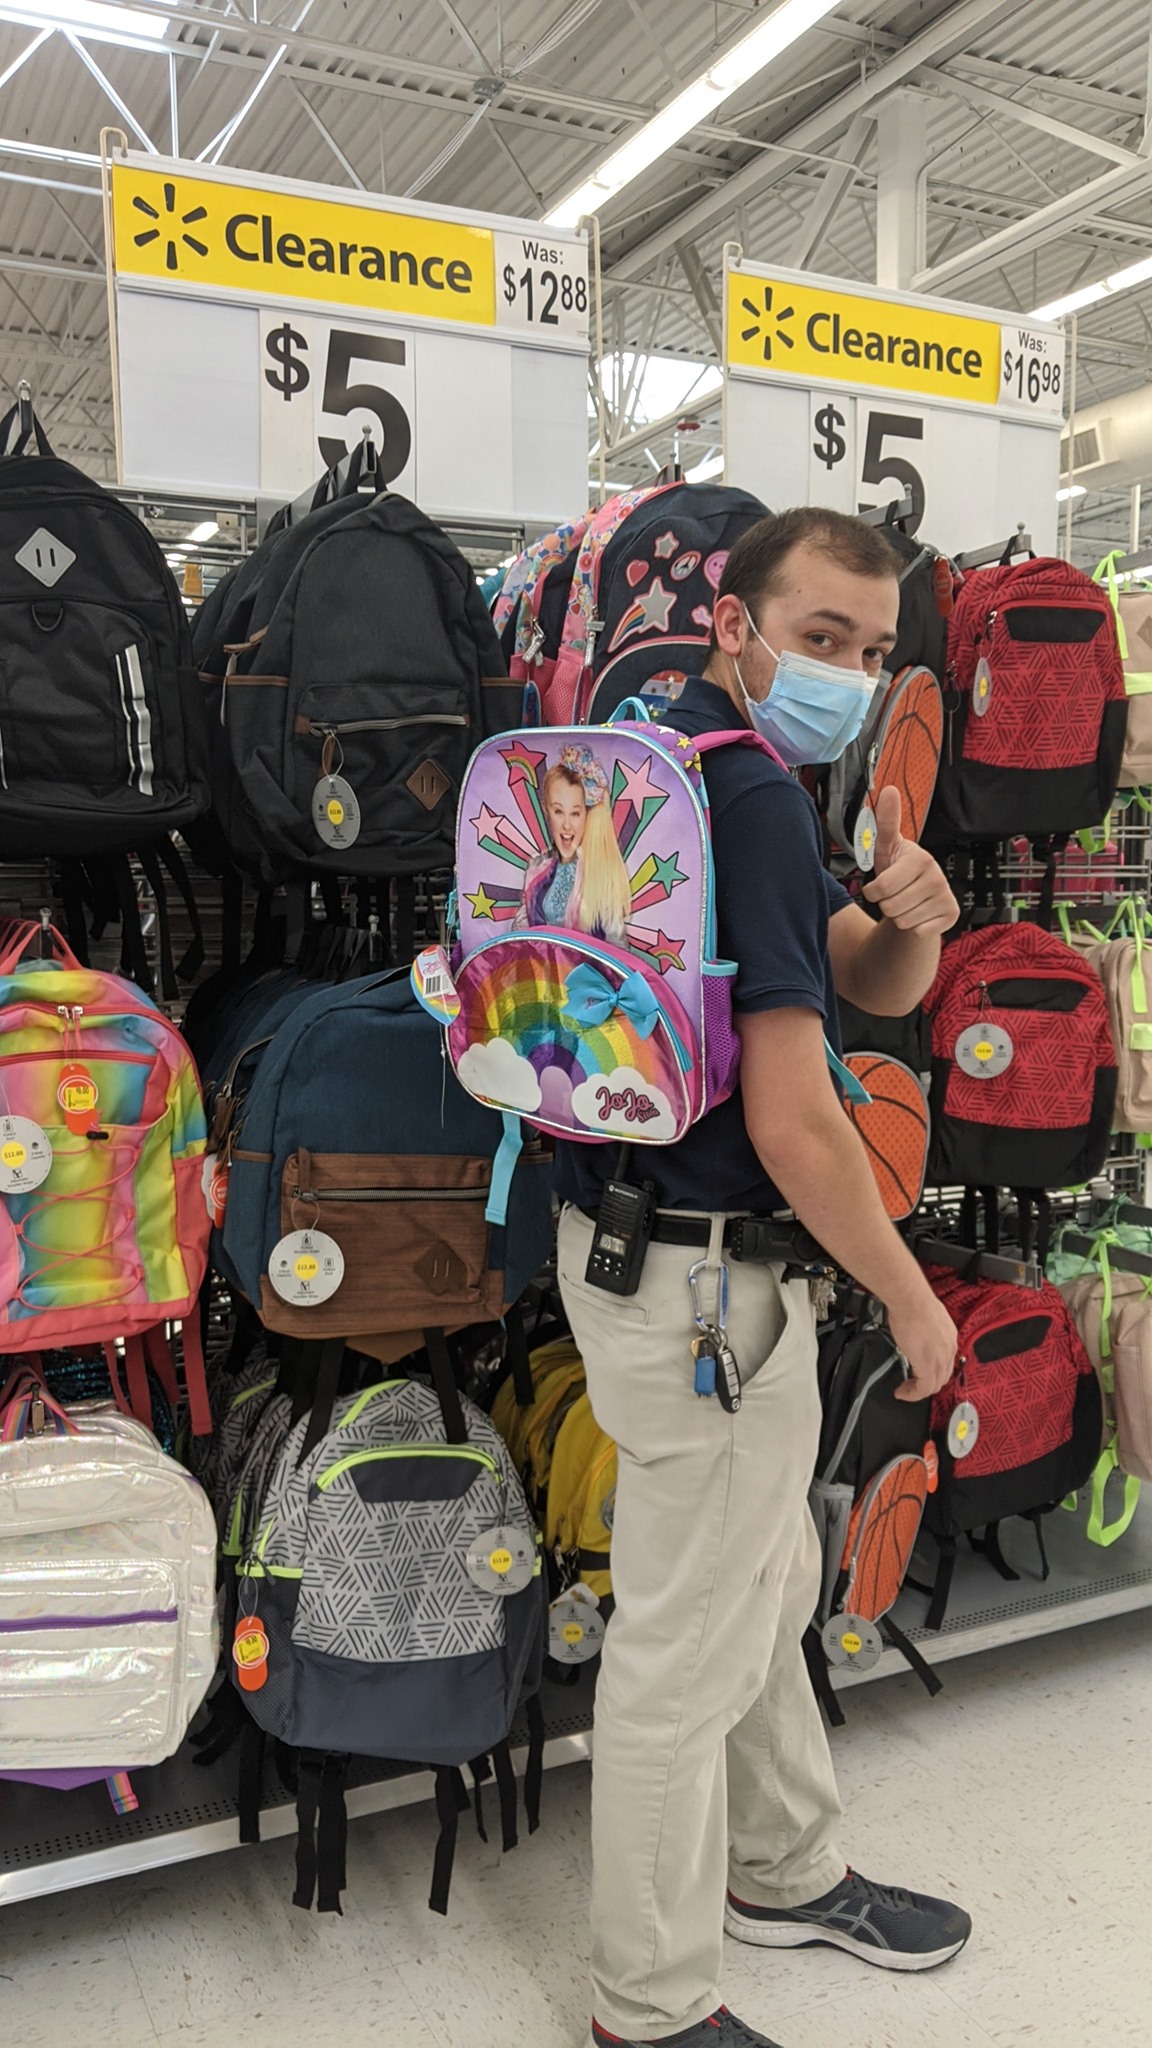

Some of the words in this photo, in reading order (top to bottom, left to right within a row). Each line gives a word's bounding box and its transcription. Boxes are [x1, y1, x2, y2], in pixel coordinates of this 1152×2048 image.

[225, 213, 473, 294] Clearance
[522, 240, 564, 266] Was:
[806, 312, 983, 379] Clearance
[1018, 330, 1048, 354] Was:
[595, 1086, 655, 1121] JoJo
